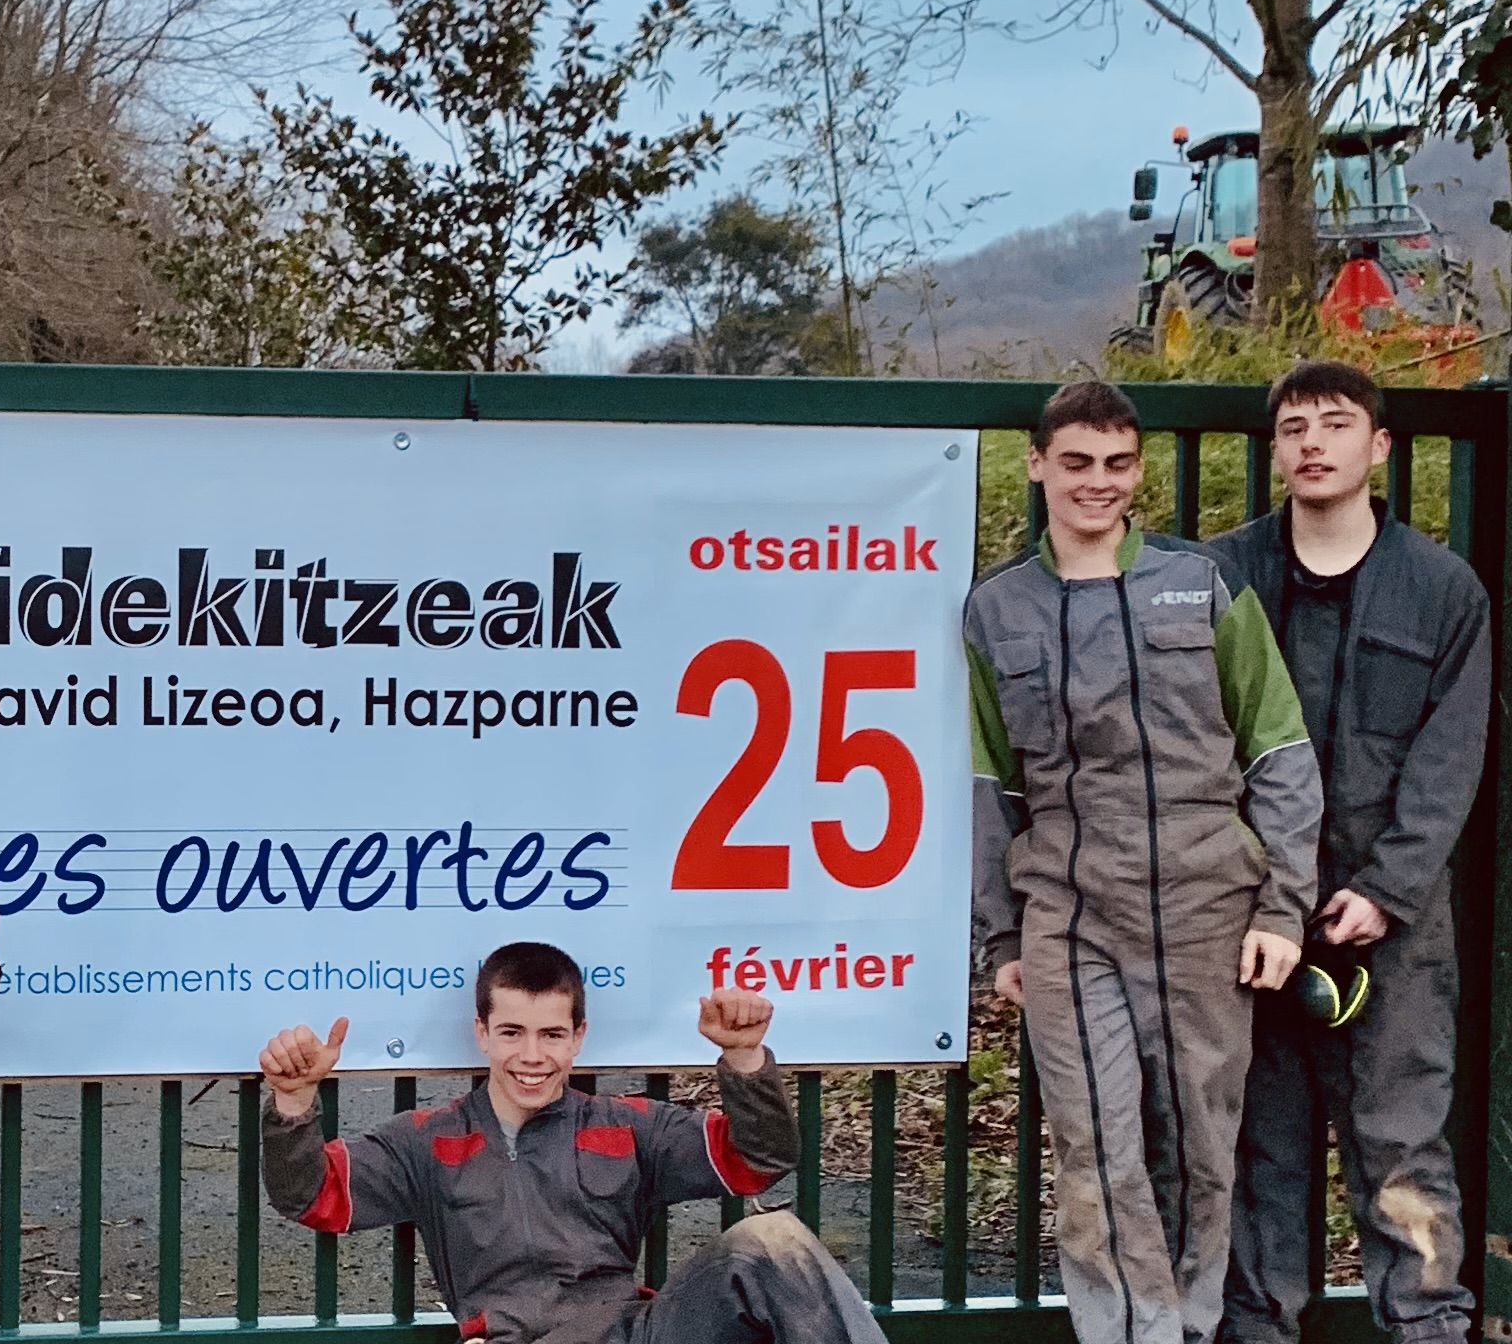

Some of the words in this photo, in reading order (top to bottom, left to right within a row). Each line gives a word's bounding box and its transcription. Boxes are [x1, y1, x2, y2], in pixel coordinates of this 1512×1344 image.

[688, 524, 938, 573] otsailak
[143, 674, 341, 734] Lizeoa,
[364, 677, 639, 740] Hazparne
[671, 639, 925, 891] 25
[156, 820, 611, 914] ouvertes
[263, 959, 465, 997] catholiques
[707, 943, 915, 991] février
